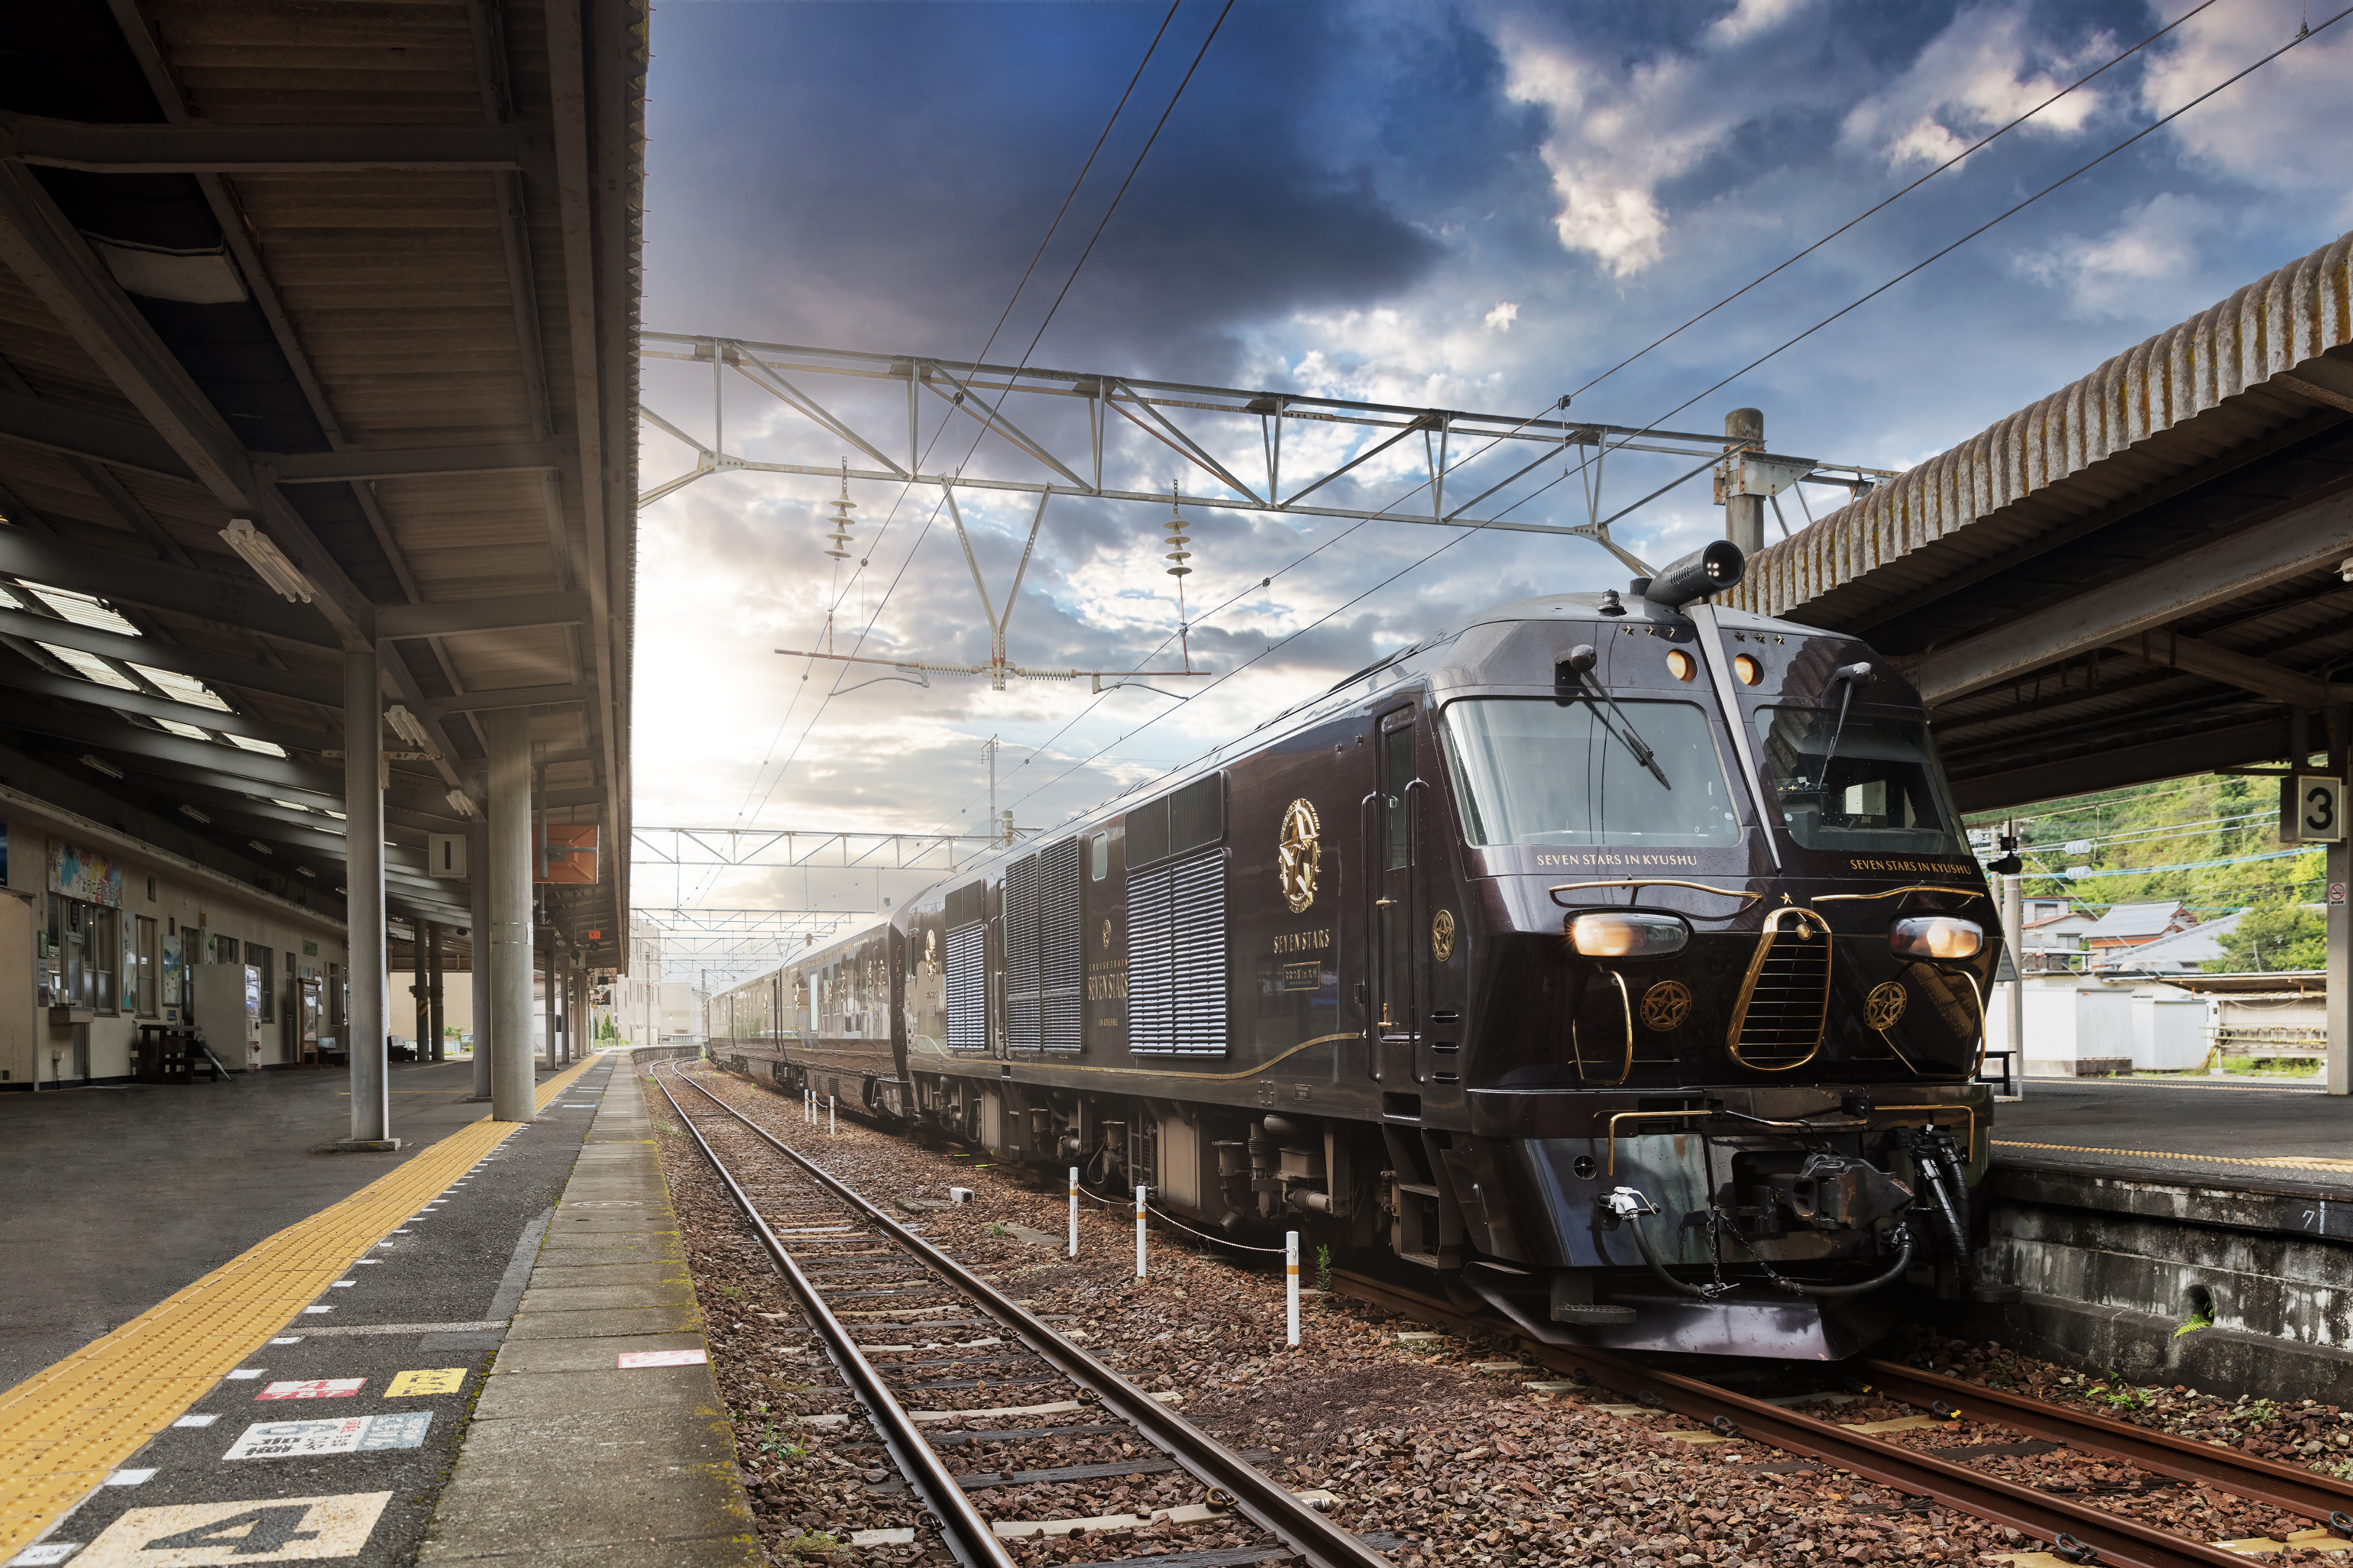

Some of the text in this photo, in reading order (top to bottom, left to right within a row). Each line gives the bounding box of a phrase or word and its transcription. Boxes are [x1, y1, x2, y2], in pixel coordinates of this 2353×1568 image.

[2306, 787, 2333, 830] 3
[445, 841, 451, 870] 1
[1537, 854, 1697, 866] SEVEN STARS IN KYUSHU
[1850, 859, 1972, 875] SEVEN STARS IN KYUSHU
[1274, 929, 1330, 954] SEVEN STARS
[1089, 959, 1128, 971] CRUISE TRAIN
[1088, 972, 1128, 1001] SEVEN STARS
[1099, 1018, 1118, 1026] IN KYUSHU
[296, 1380, 330, 1390] 4
[271, 1390, 341, 1399] 787
[141, 1503, 322, 1554] 4
